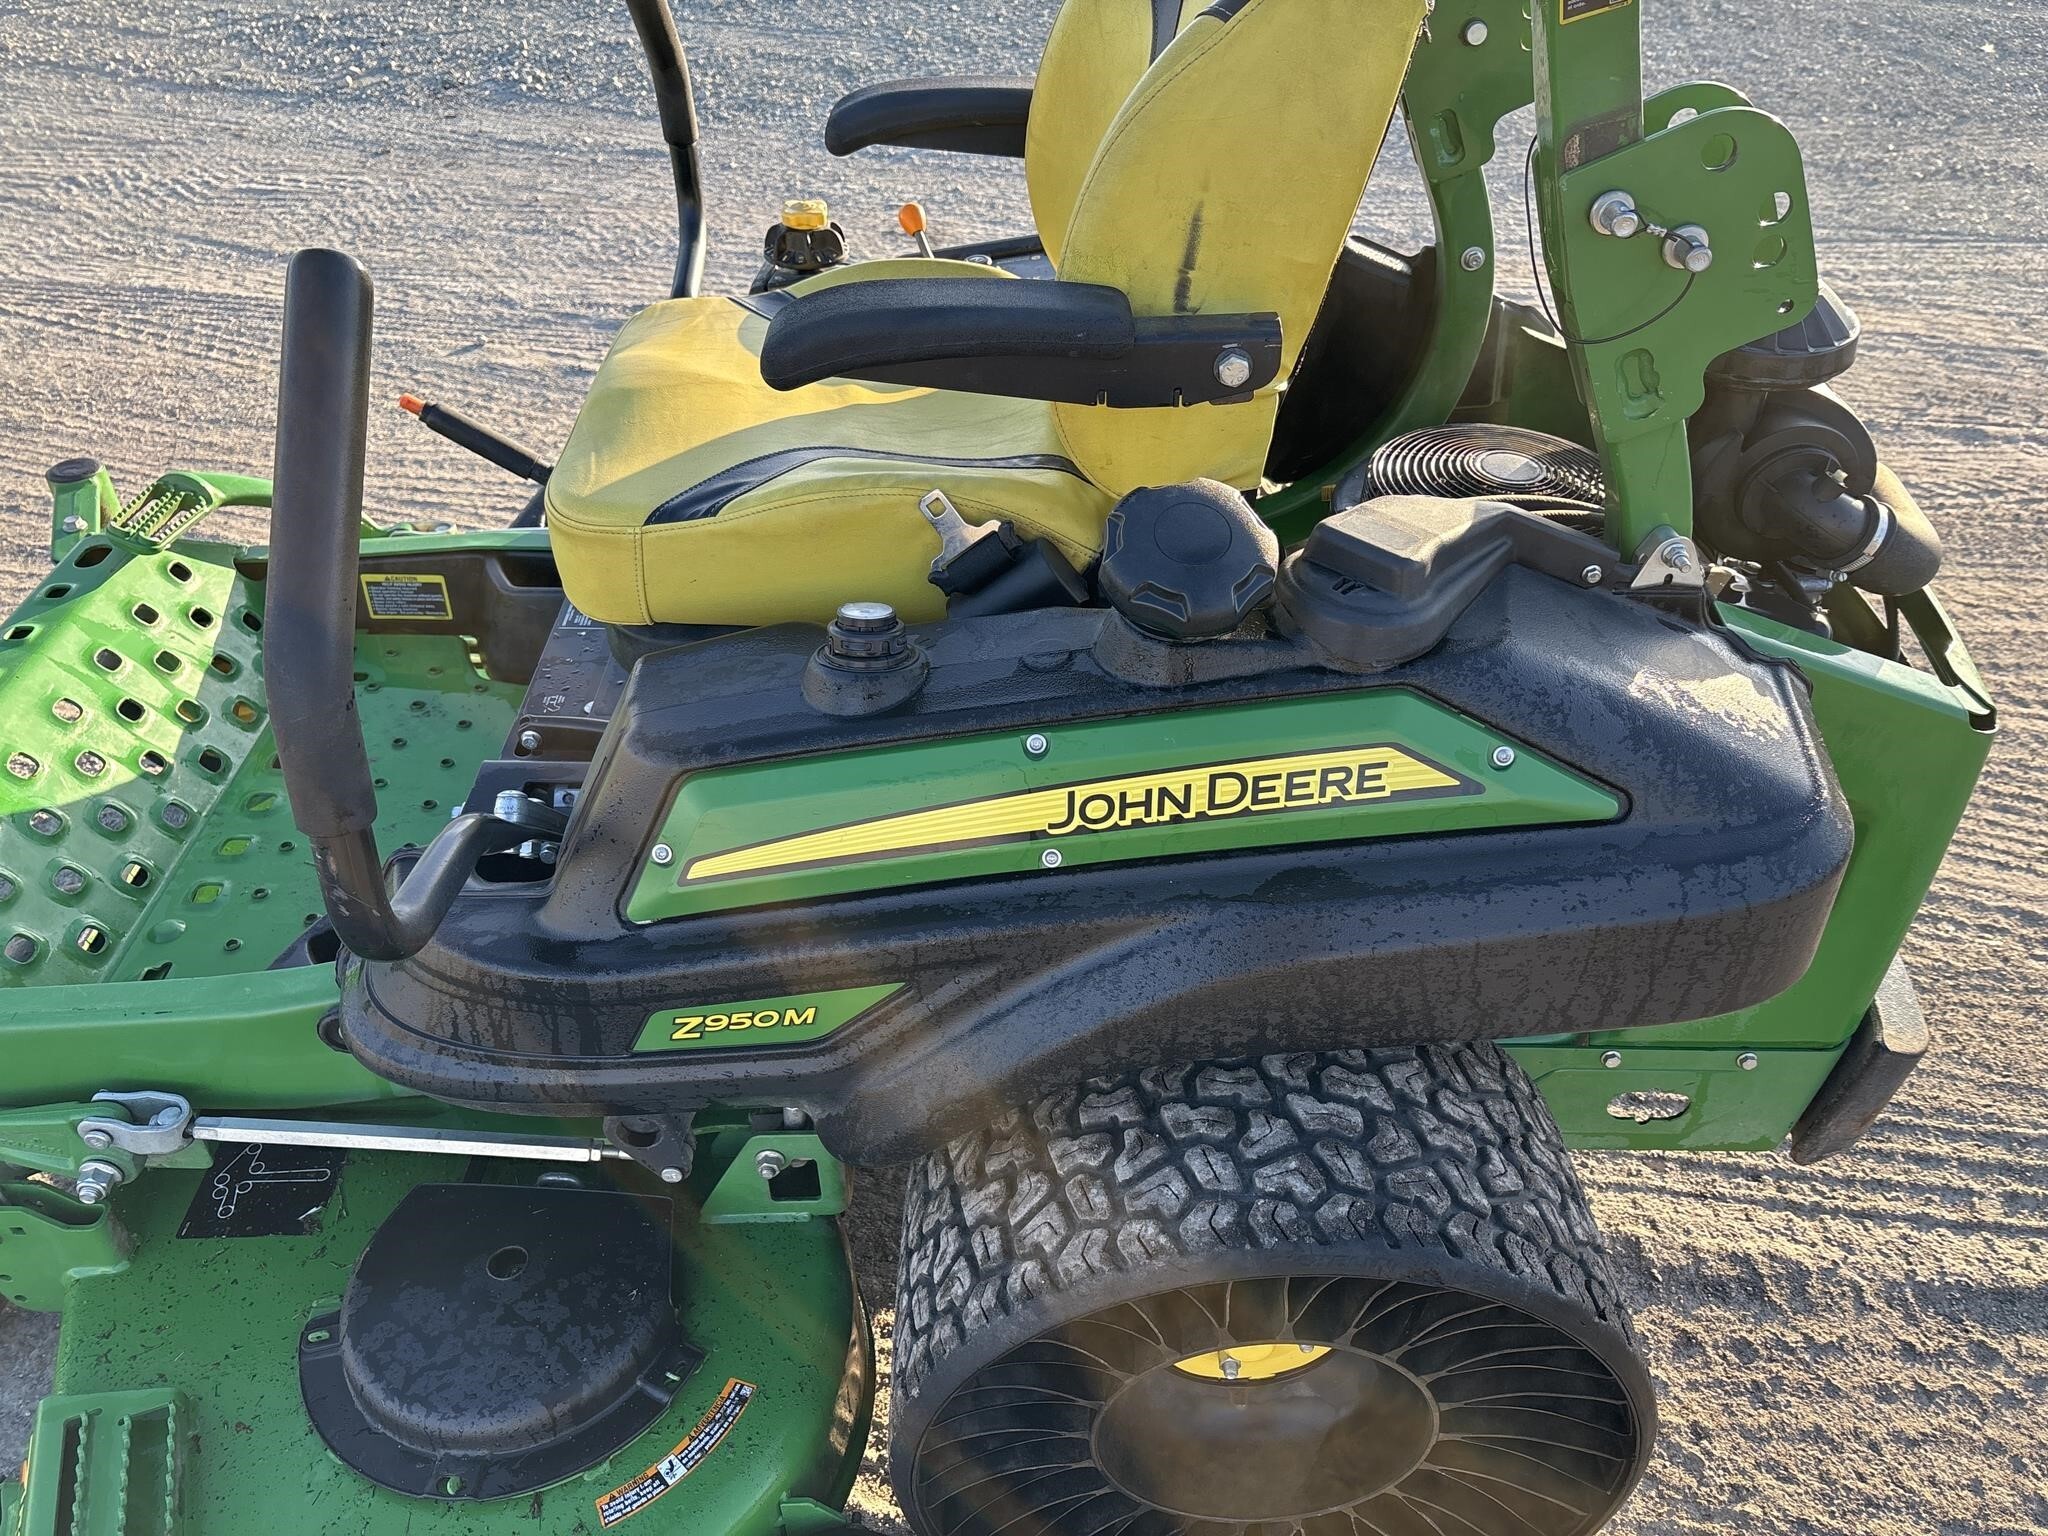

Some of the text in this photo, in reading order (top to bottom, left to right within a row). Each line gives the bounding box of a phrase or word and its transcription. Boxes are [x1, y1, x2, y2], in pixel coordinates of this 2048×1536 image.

[1046, 760, 1391, 832] JOHN DEERE
[671, 1007, 817, 1041] Z950M
[693, 1395, 725, 1434] ADVERTENCIA
[616, 1472, 648, 1495] WARNING
[640, 1486, 652, 1495] keep
[609, 1496, 624, 1506] avoid
[624, 1487, 639, 1498] injury
[631, 1496, 646, 1508] guards
